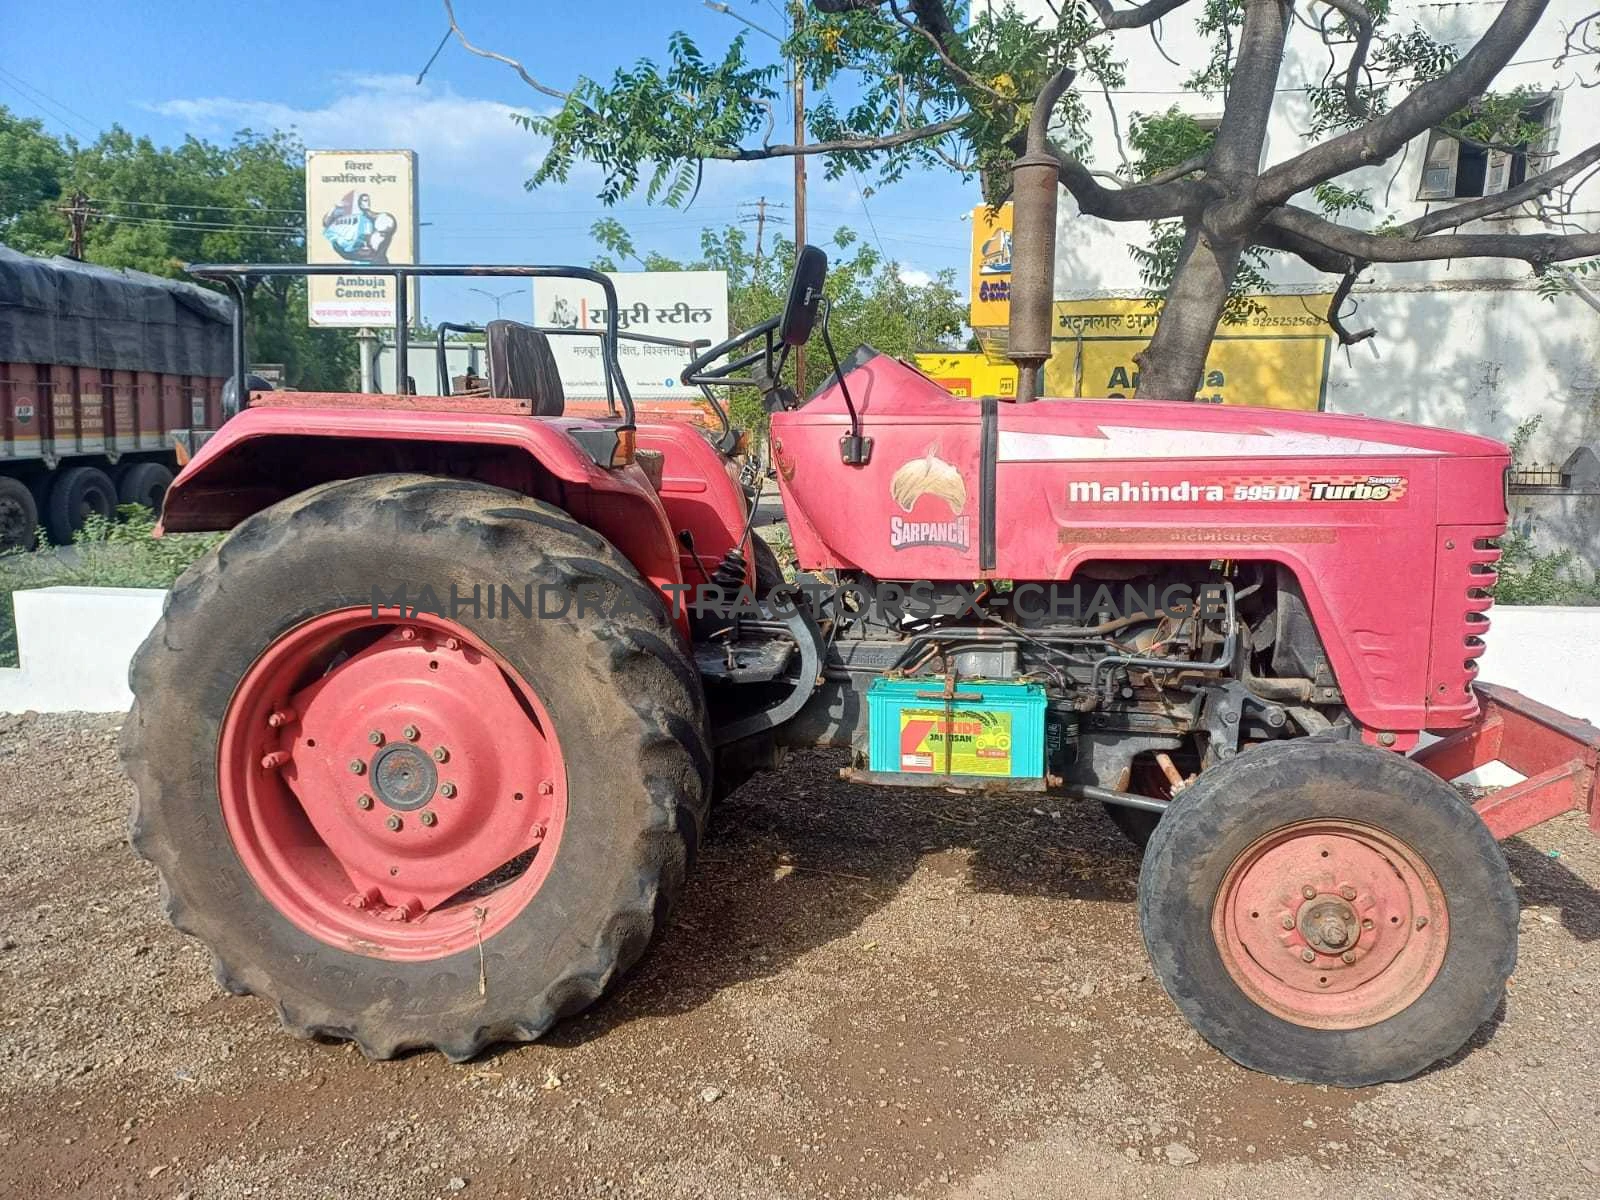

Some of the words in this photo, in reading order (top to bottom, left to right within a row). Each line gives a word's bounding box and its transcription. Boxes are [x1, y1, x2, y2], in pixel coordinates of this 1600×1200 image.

[336, 276, 386, 288] Ambuja
[335, 287, 386, 298] Cement
[655, 302, 712, 324] स्टील
[1368, 476, 1402, 485] Super
[1069, 482, 1224, 502] Mahindra
[1309, 482, 1391, 501] Turbo
[890, 514, 970, 548] SARPANCH
